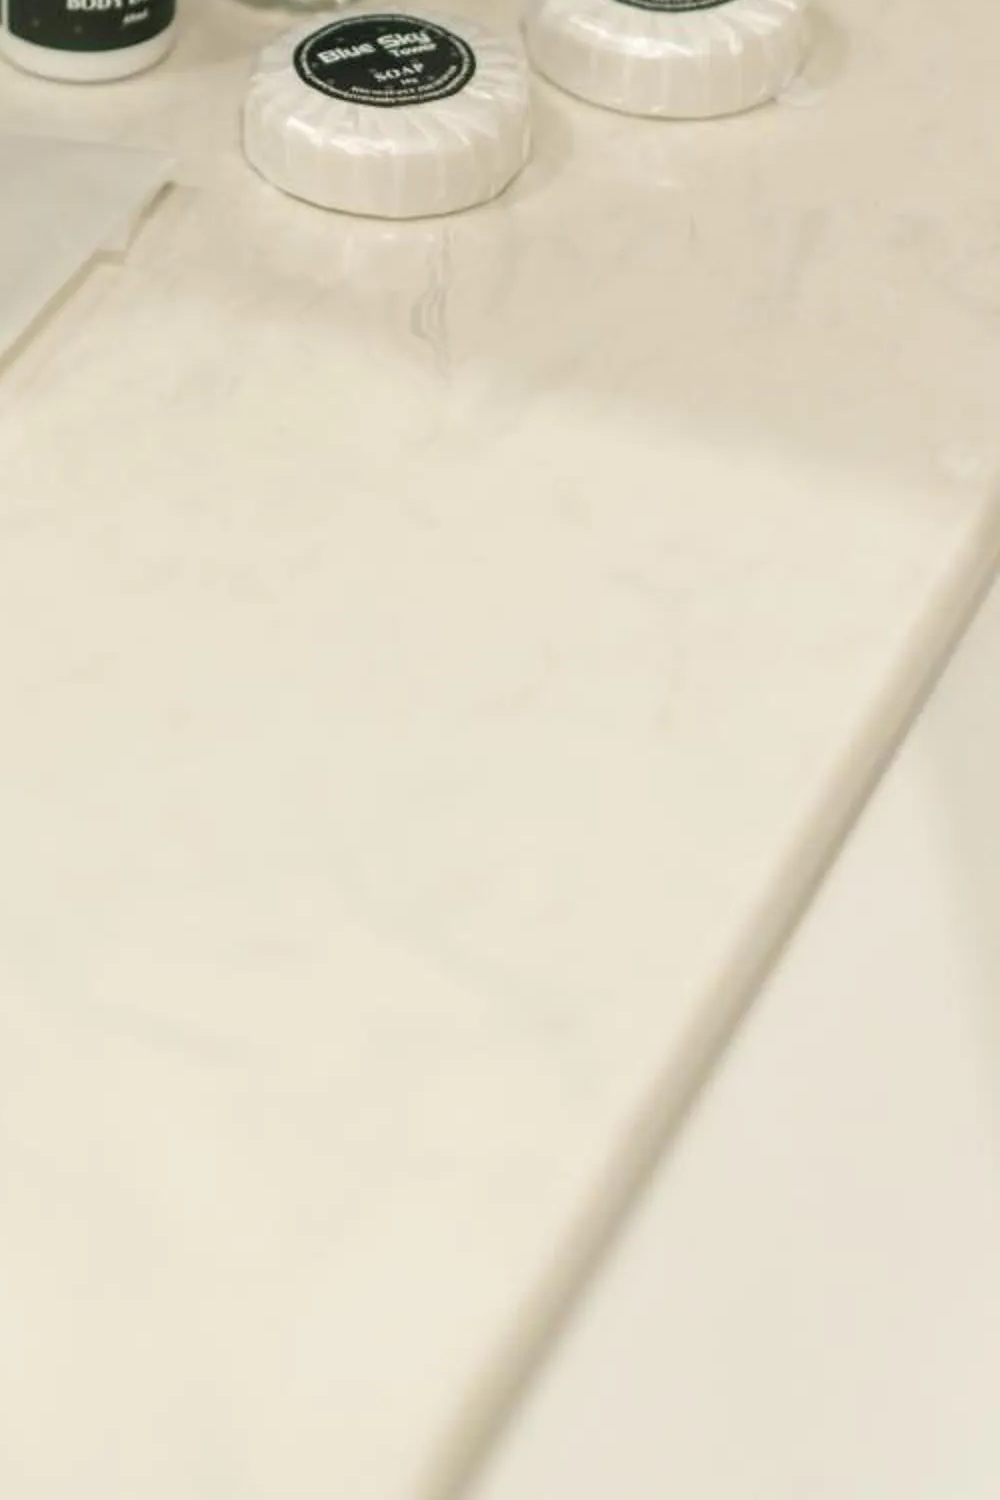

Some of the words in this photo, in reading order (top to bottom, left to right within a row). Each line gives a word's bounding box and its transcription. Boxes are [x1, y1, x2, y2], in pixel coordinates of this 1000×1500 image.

[317, 43, 376, 64] Blue
[376, 29, 432, 50] Sky
[373, 63, 424, 83] SOAP
